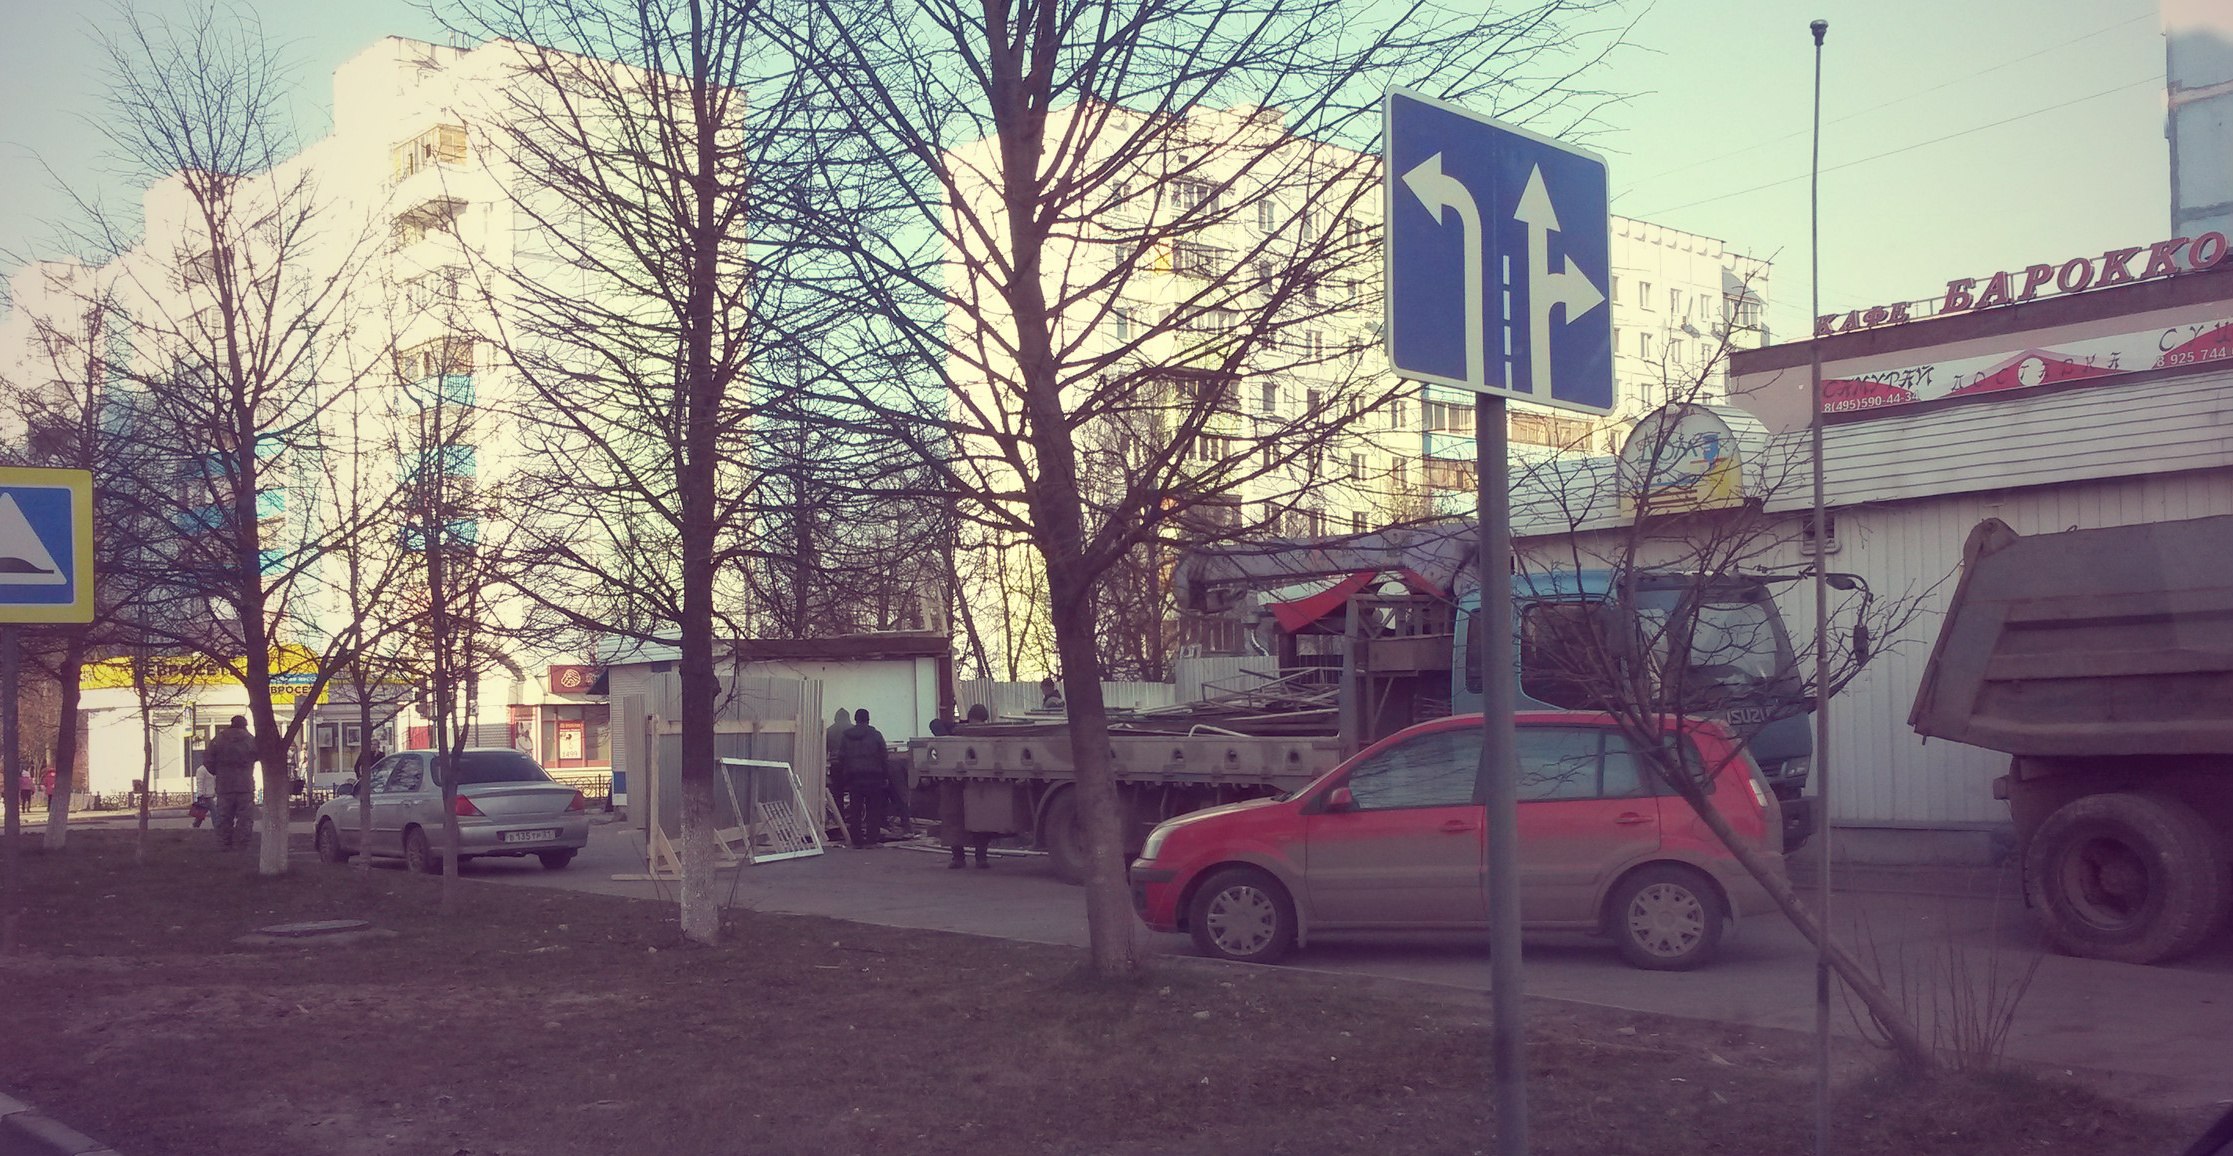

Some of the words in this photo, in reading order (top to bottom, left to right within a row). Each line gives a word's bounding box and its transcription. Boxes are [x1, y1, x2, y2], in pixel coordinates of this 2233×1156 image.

[1815, 301, 1910, 335] КАФЕ
[1938, 231, 2228, 315] БАРОККО
[2156, 355, 2165, 367] 8
[2170, 351, 2195, 365] 925
[2200, 346, 2226, 361] 744
[1824, 391, 1918, 413] 8(495)590-44-34
